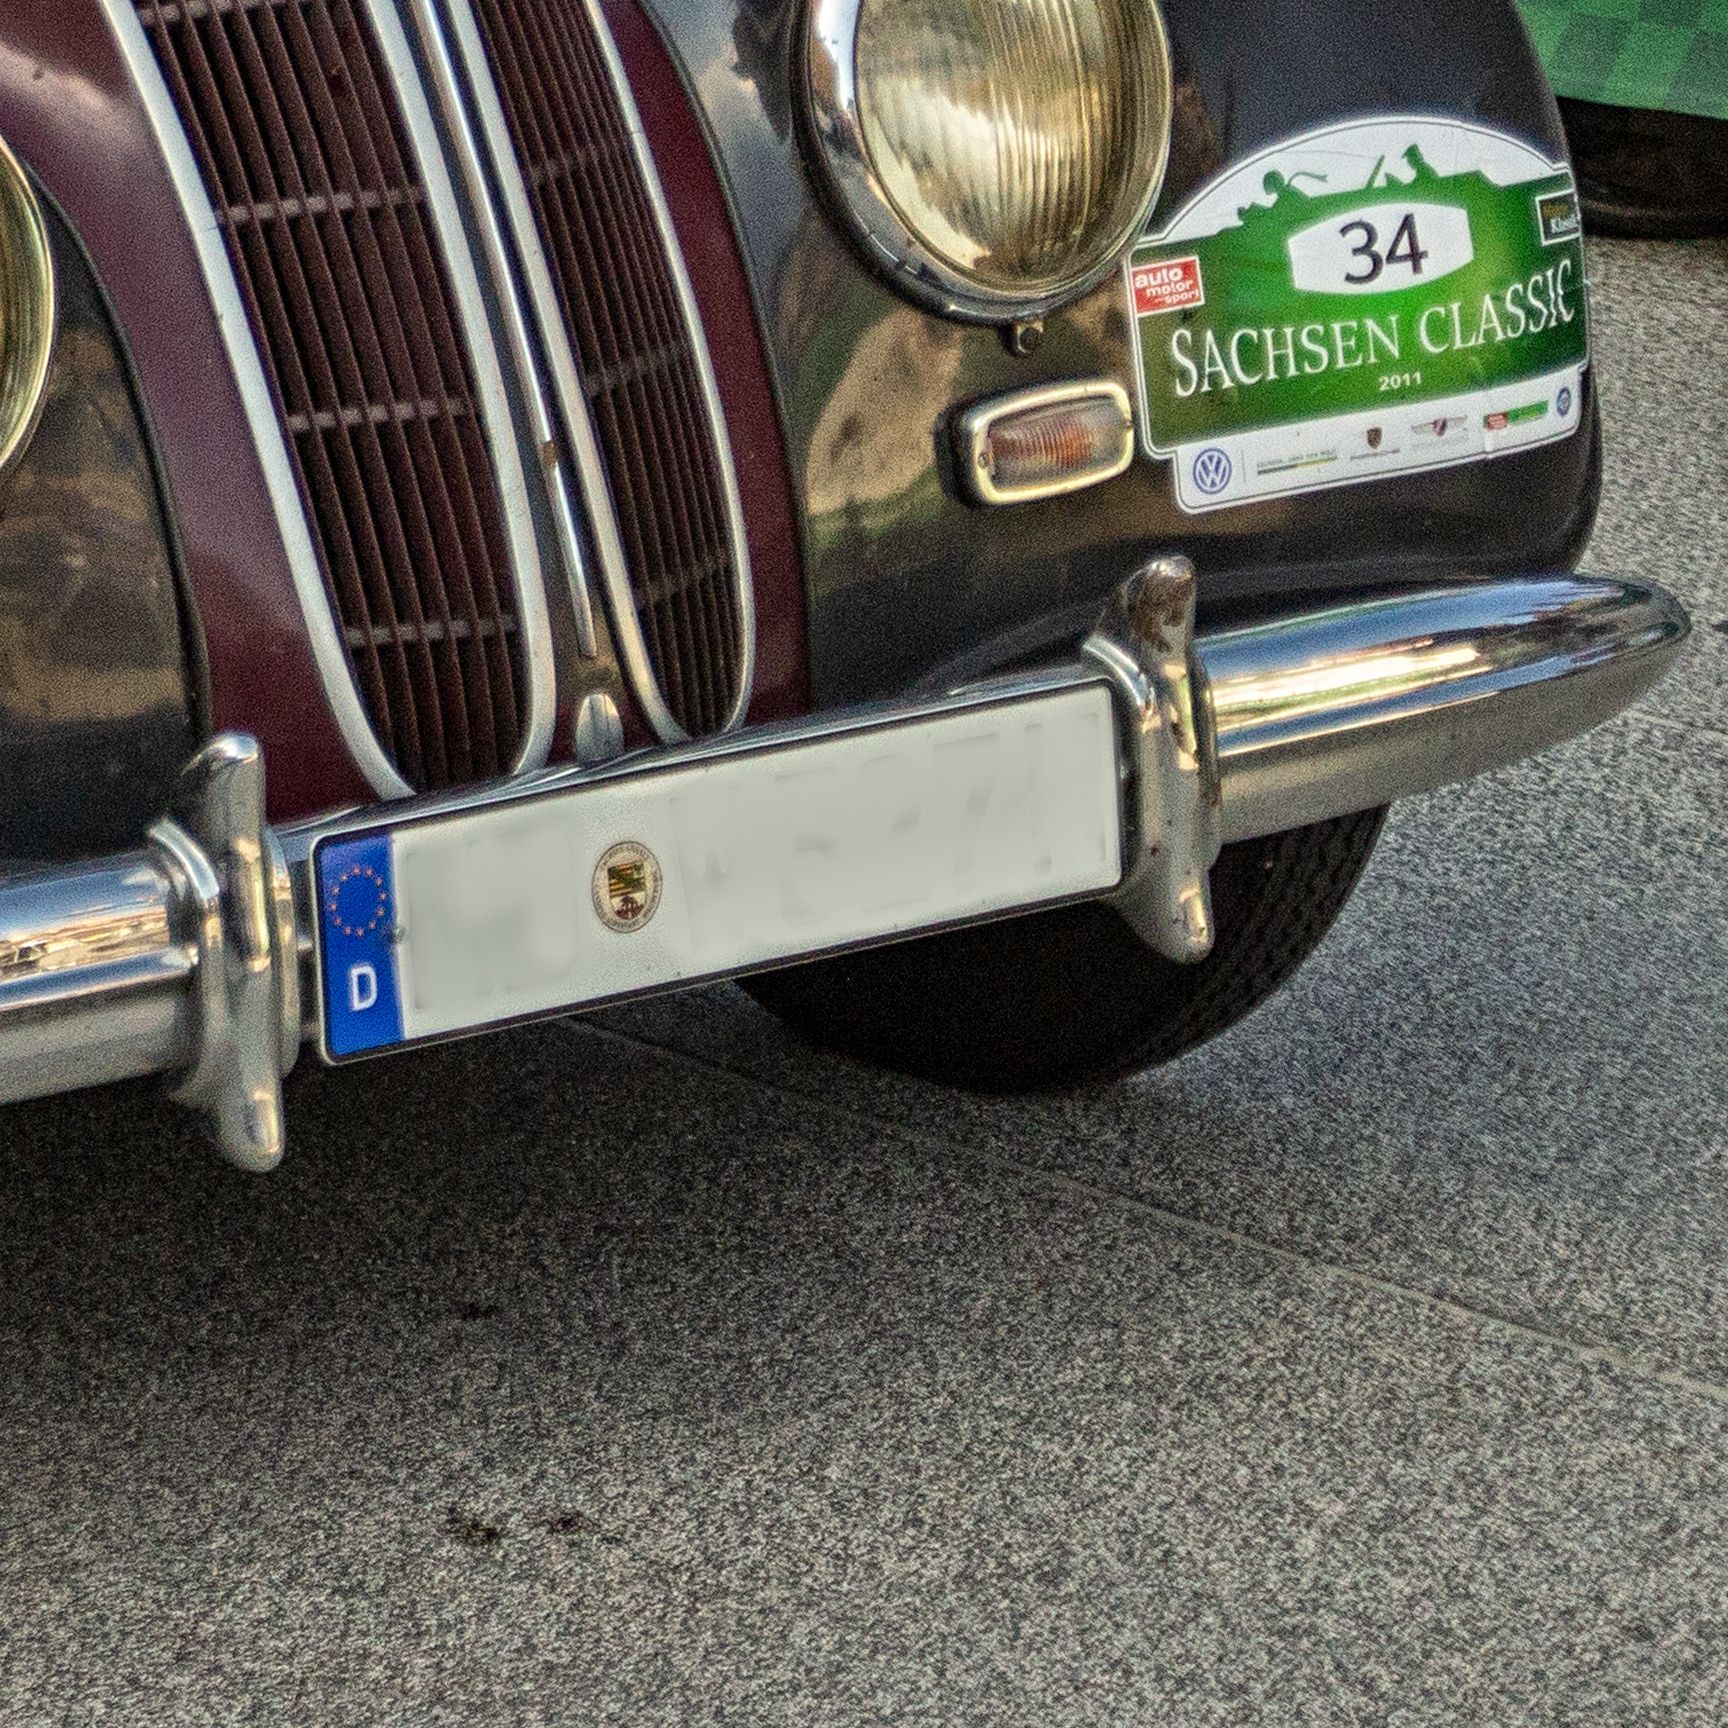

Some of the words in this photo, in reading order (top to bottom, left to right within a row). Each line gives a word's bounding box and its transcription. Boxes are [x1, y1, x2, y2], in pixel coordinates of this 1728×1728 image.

[1339, 212, 1428, 286] 34
[1135, 267, 1184, 288] auto
[1145, 279, 1195, 298] motor
[1171, 313, 1402, 398] SACHSEN
[1419, 258, 1575, 355] CLASSIC
[1378, 372, 1422, 391] 2011
[348, 965, 379, 1011] D
